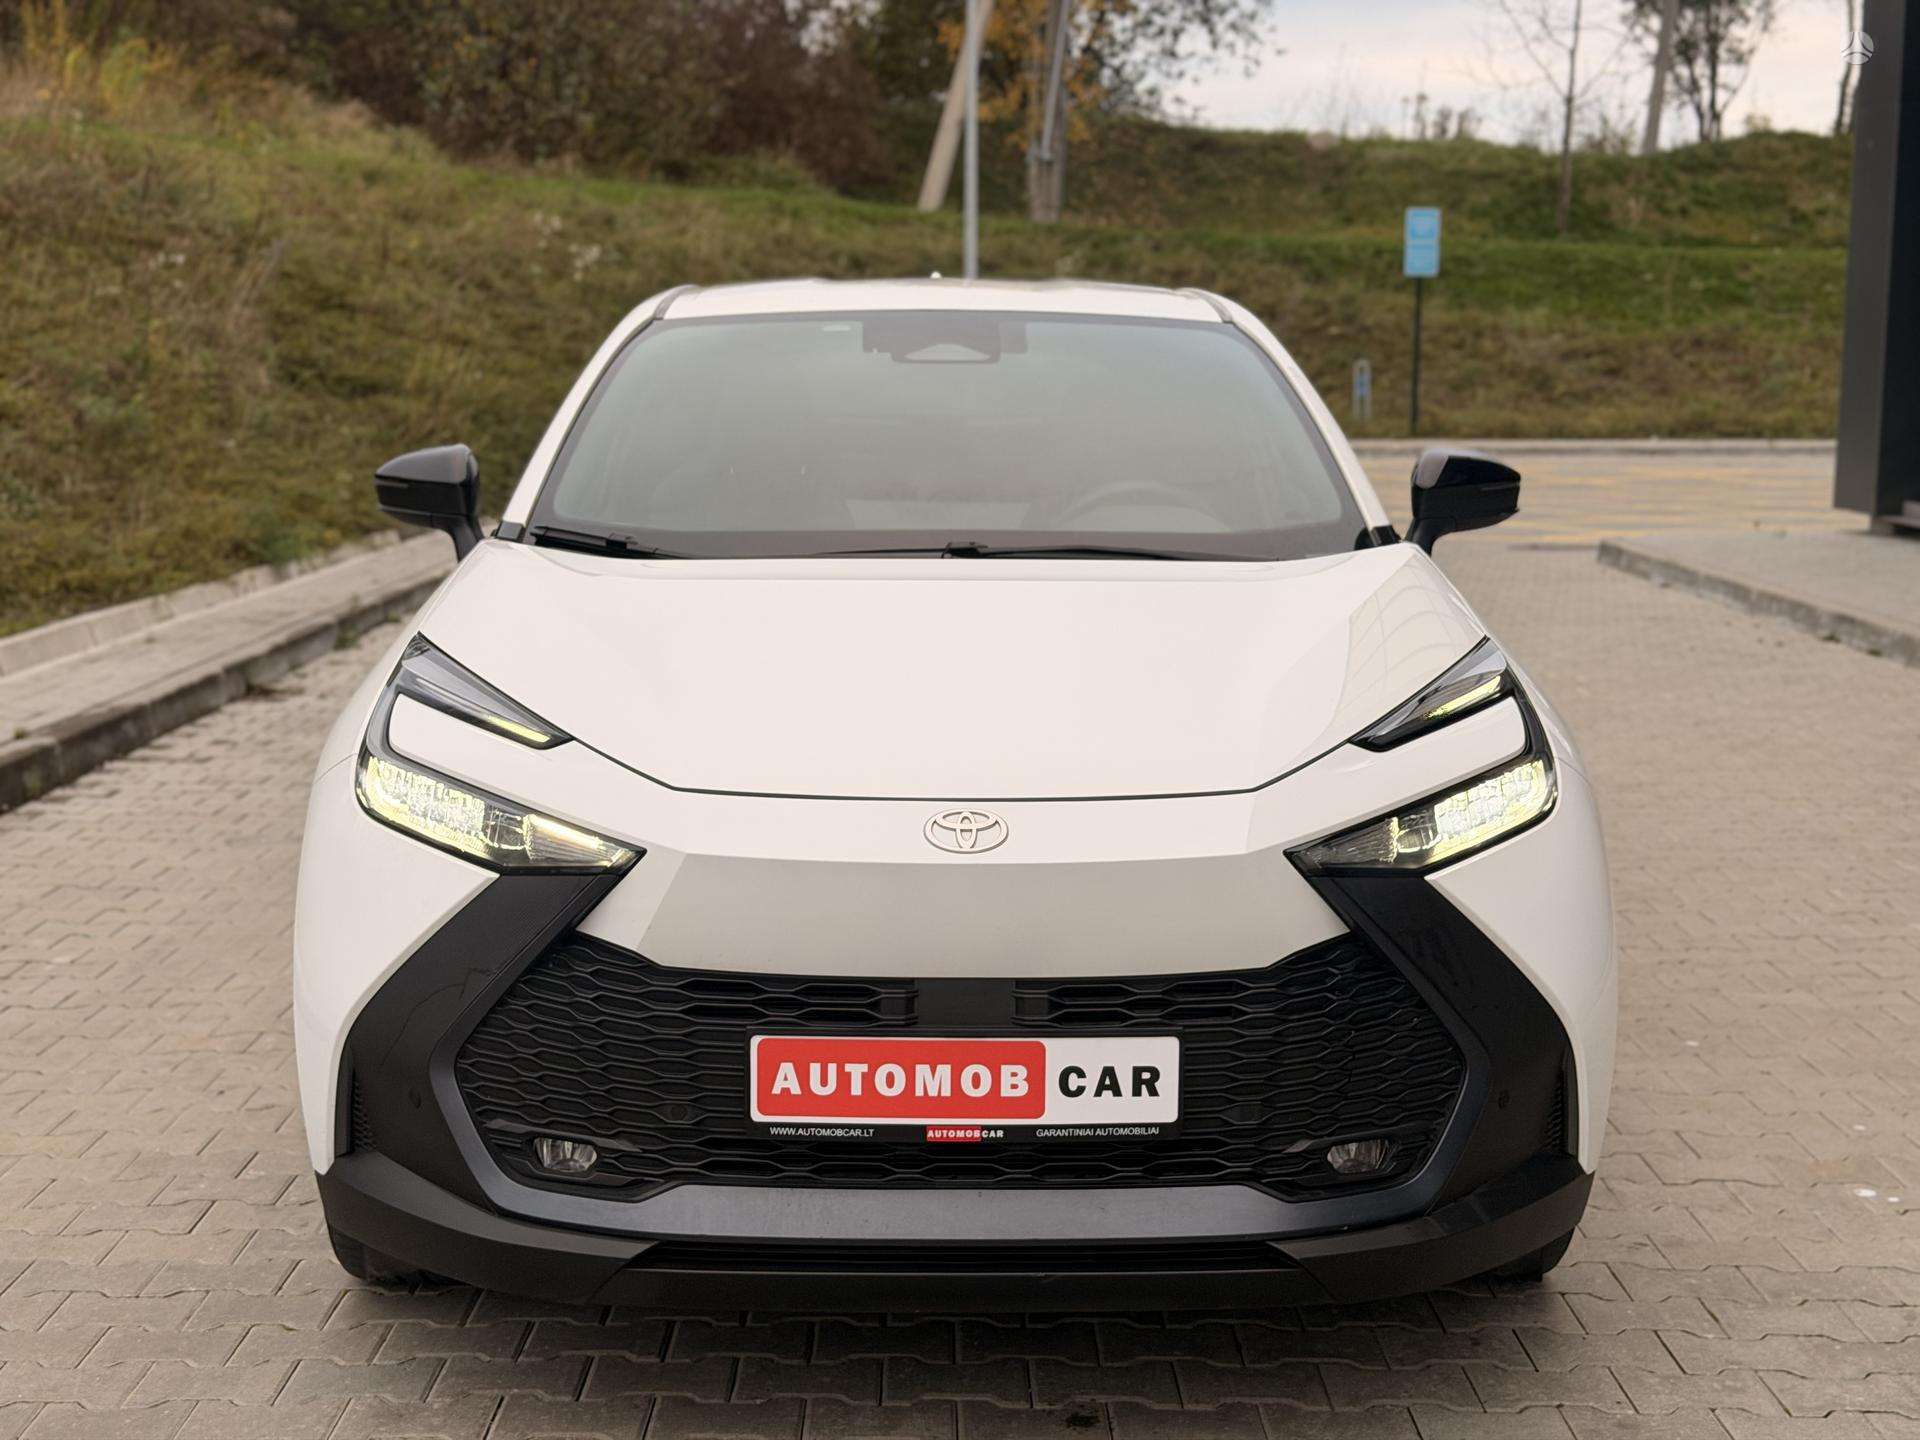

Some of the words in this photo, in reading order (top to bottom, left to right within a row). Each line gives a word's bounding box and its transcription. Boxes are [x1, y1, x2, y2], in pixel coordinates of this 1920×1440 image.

[771, 1061, 1029, 1098] AUTOMOB
[1057, 1065, 1161, 1098] CAR
[769, 1126, 875, 1138] WWW.AUTOMOBCAR.LT
[926, 1129, 1005, 1139] AUTOMOBCAR
[1036, 1128, 1094, 1138] GARANTINIAI
[1095, 1126, 1160, 1137] AUTOMOBILIAI
